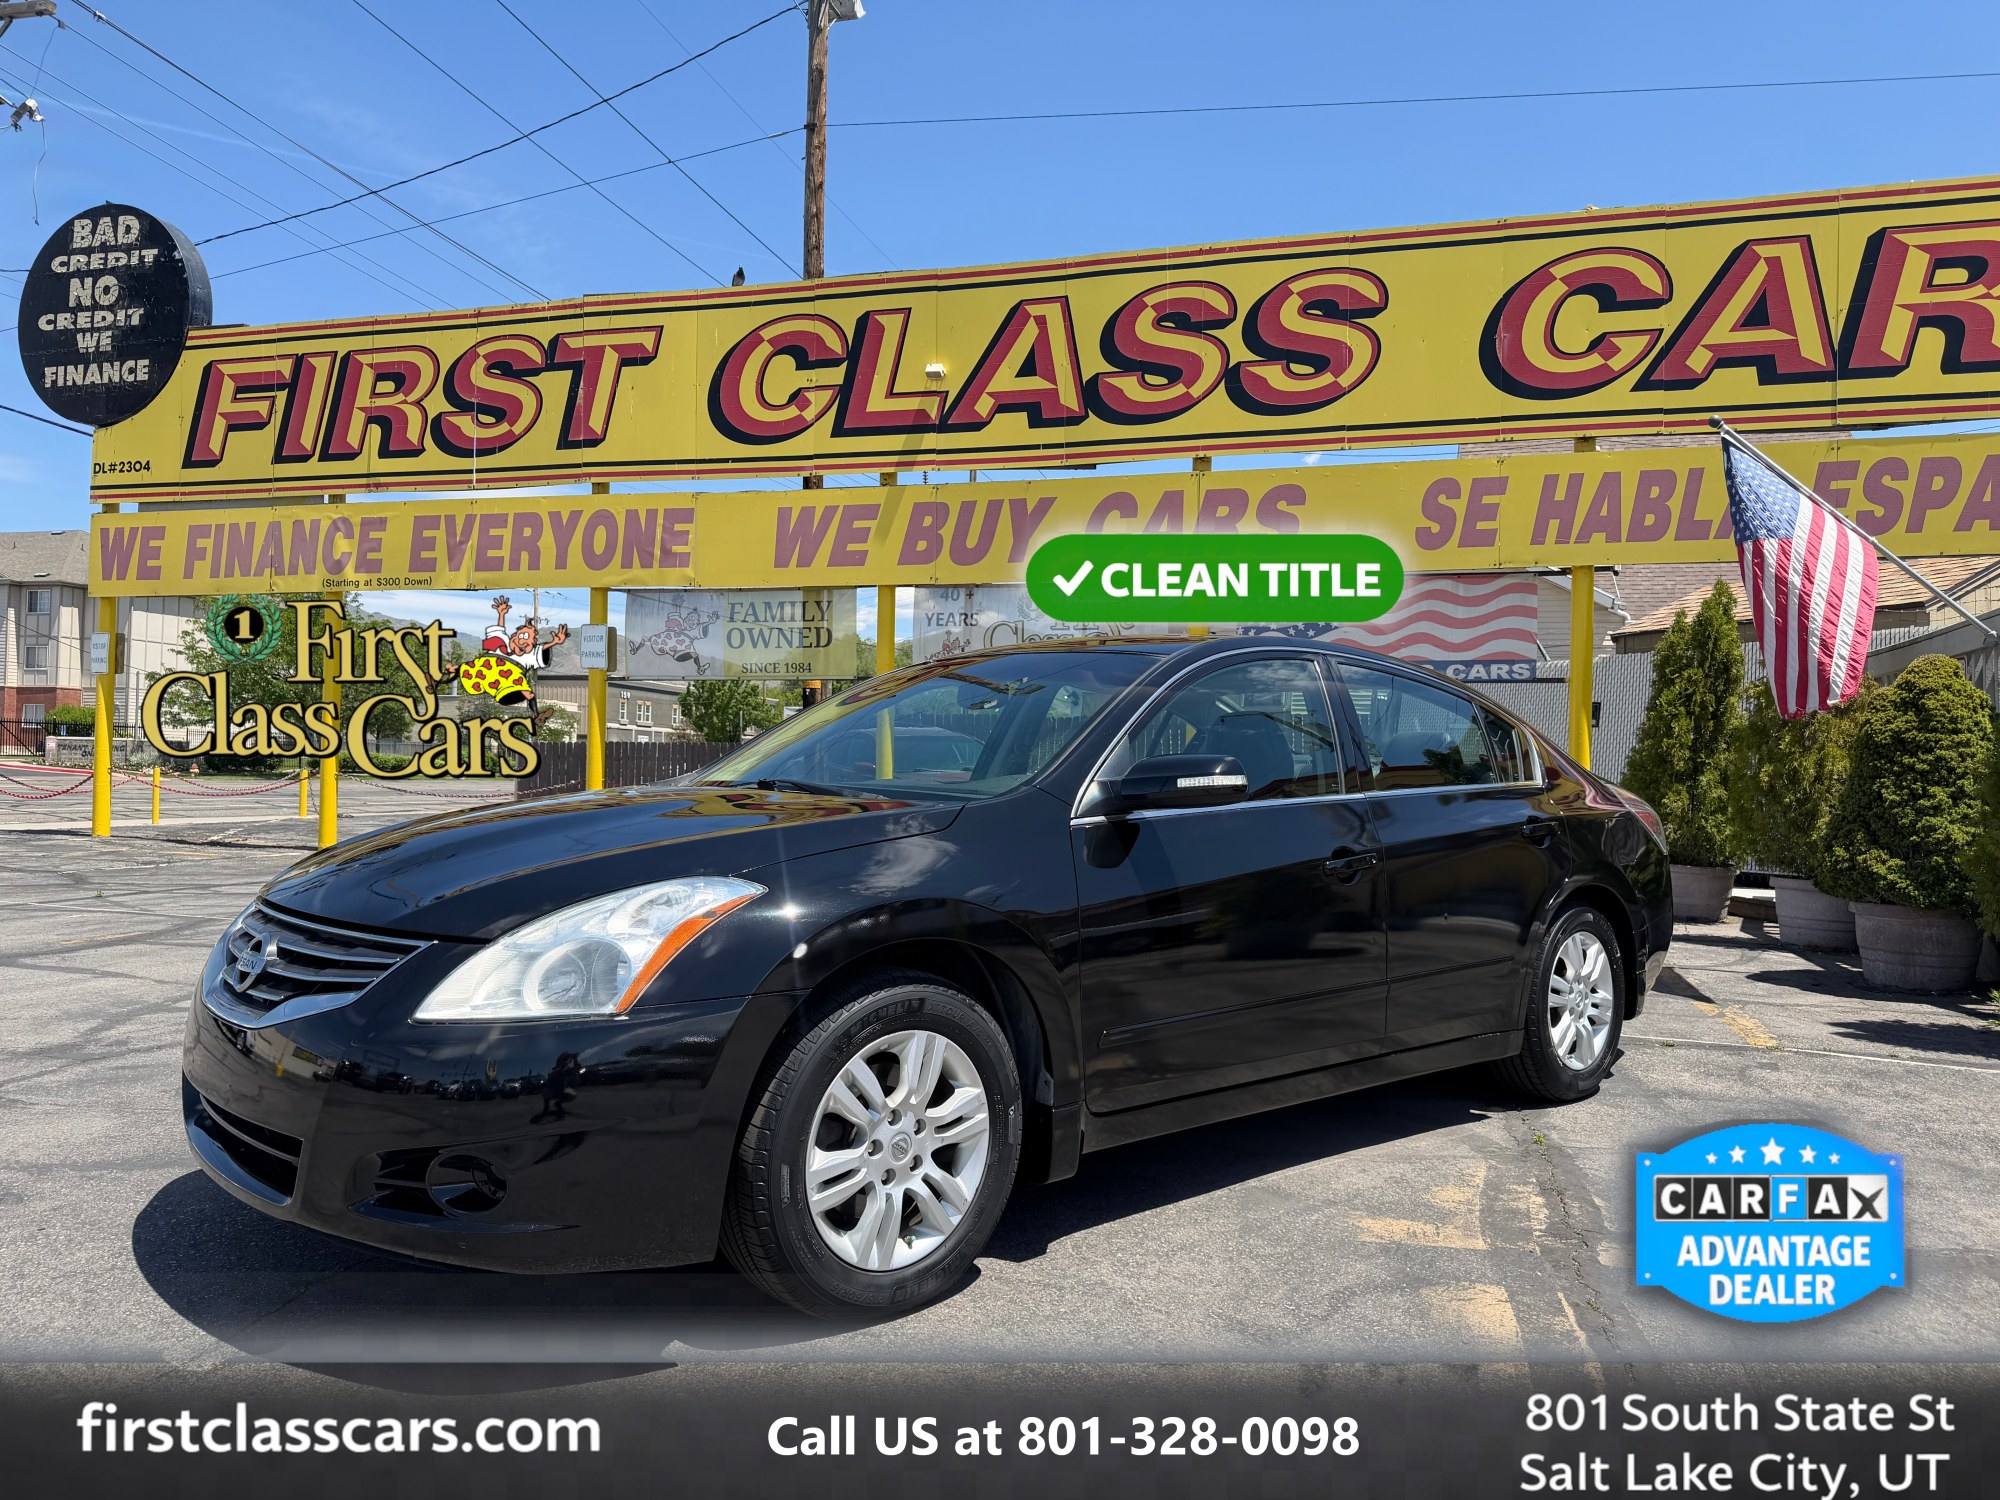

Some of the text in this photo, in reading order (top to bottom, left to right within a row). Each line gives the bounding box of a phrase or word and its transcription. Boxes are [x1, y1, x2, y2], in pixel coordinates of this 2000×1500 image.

[71, 215, 141, 249] BAD
[50, 248, 159, 273] CREDIT
[68, 275, 120, 308] NO
[37, 307, 145, 331] CREDIT
[76, 330, 114, 354] WE
[44, 358, 150, 388] FINANCE
[181, 325, 664, 469] FIRST
[707, 266, 1389, 446] CLASS
[93, 460, 151, 475] DL#2304
[1414, 475, 1510, 551] SE
[99, 507, 696, 581] WE FINANCE EVERYONE
[772, 502, 882, 569] WE
[897, 496, 1058, 566] BUY
[321, 576, 433, 588] (Starting at $300 Down)
[727, 600, 834, 624] FAMILY
[924, 611, 980, 627] YEARS
[583, 634, 604, 643] VISITOR
[726, 626, 834, 650] OWNED
[581, 650, 605, 659] PARKING
[741, 662, 813, 675] SINCE 1984
[1445, 663, 1531, 680] CARS
